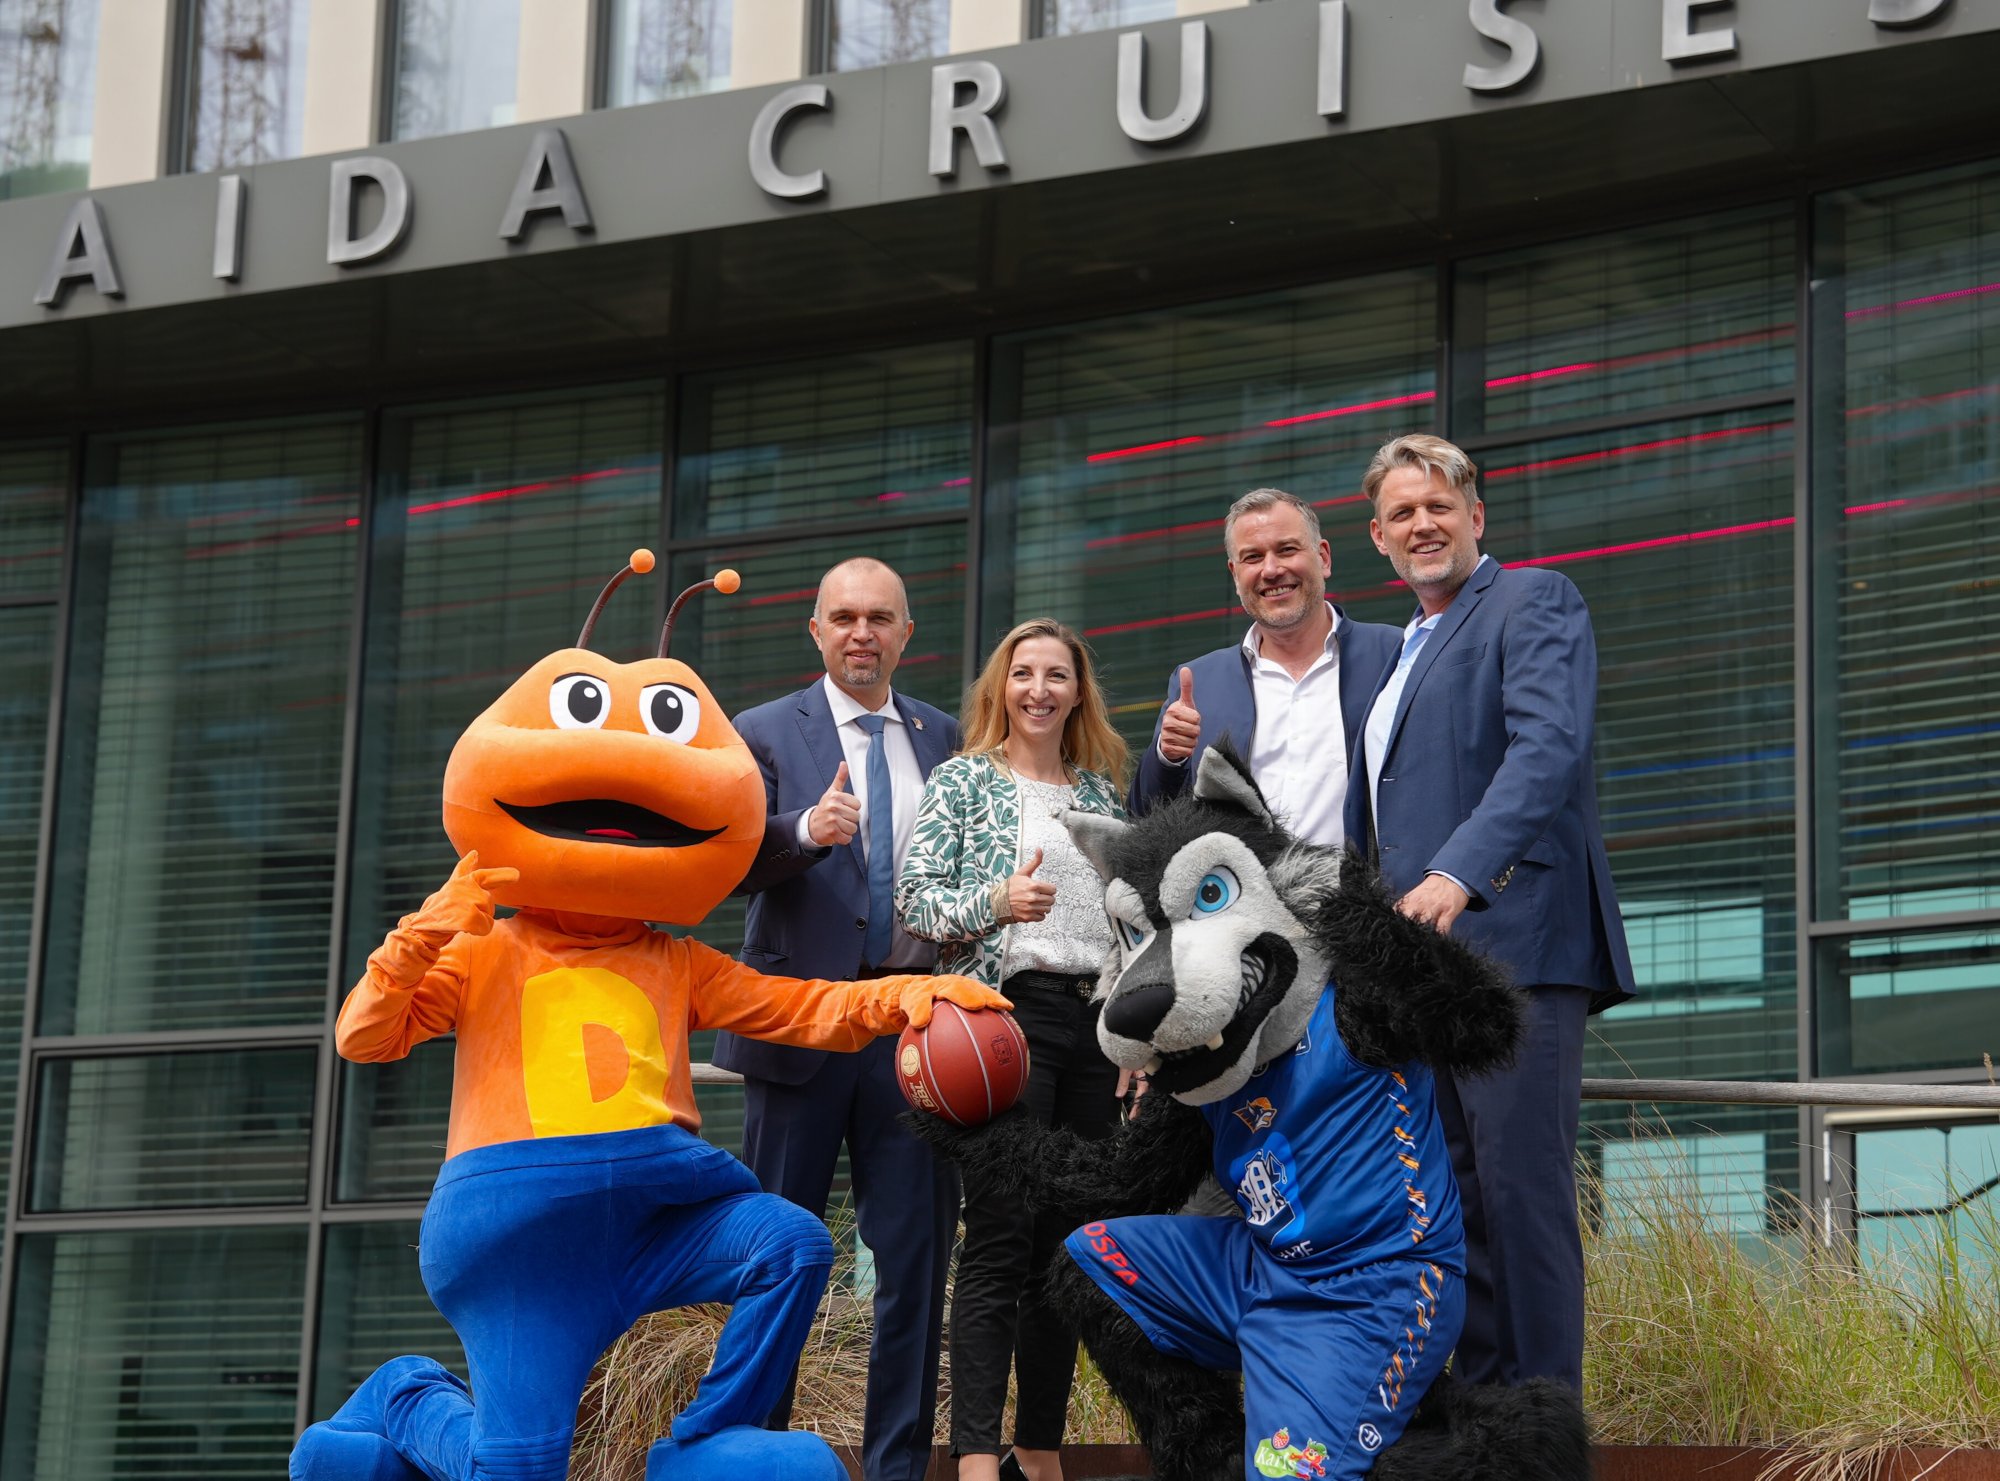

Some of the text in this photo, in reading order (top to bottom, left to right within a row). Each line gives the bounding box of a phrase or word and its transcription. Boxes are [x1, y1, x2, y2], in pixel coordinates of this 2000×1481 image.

[34, 0, 1952, 309] AIDA CRUISE
[521, 967, 673, 1138] D
[914, 1080, 934, 1108] BBL
[1083, 1222, 1139, 1287] OSPA
